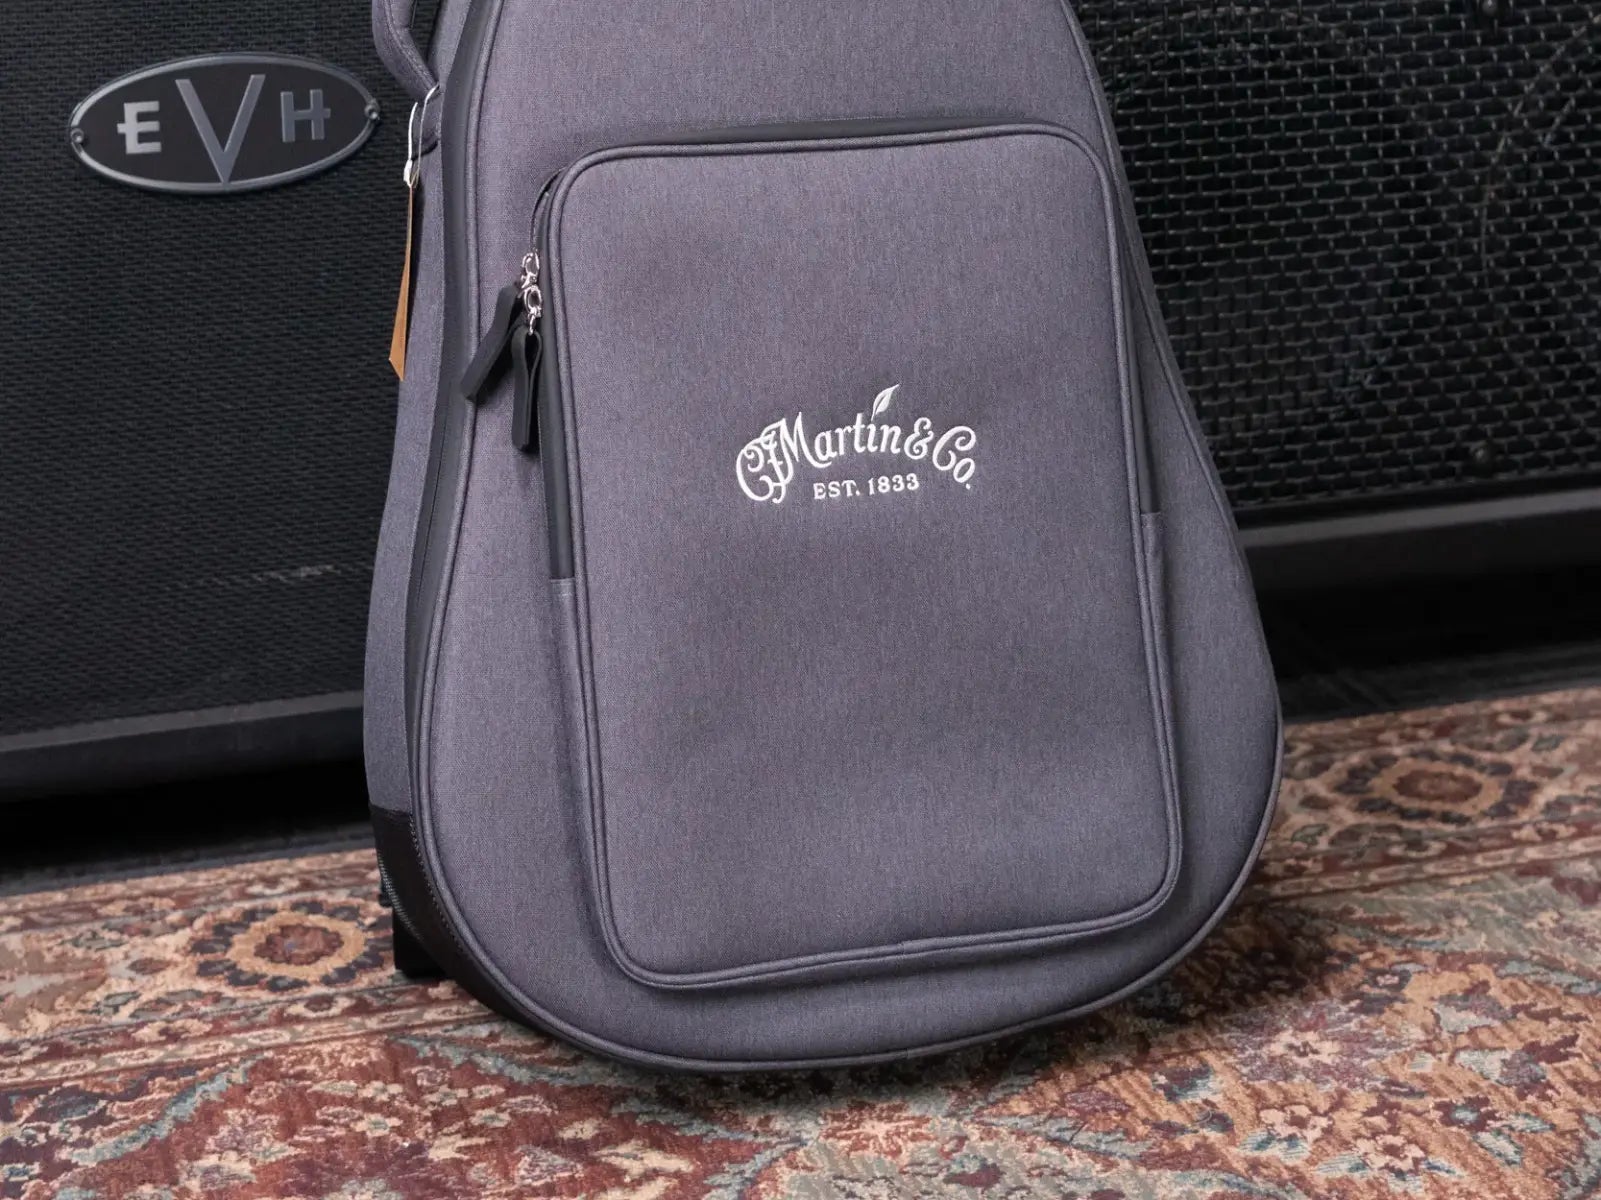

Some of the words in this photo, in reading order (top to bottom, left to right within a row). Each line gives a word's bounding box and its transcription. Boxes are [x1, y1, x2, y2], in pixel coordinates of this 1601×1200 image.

[117, 73, 332, 184] EVH
[812, 480, 861, 500] EST.
[868, 472, 920, 496] 1833
